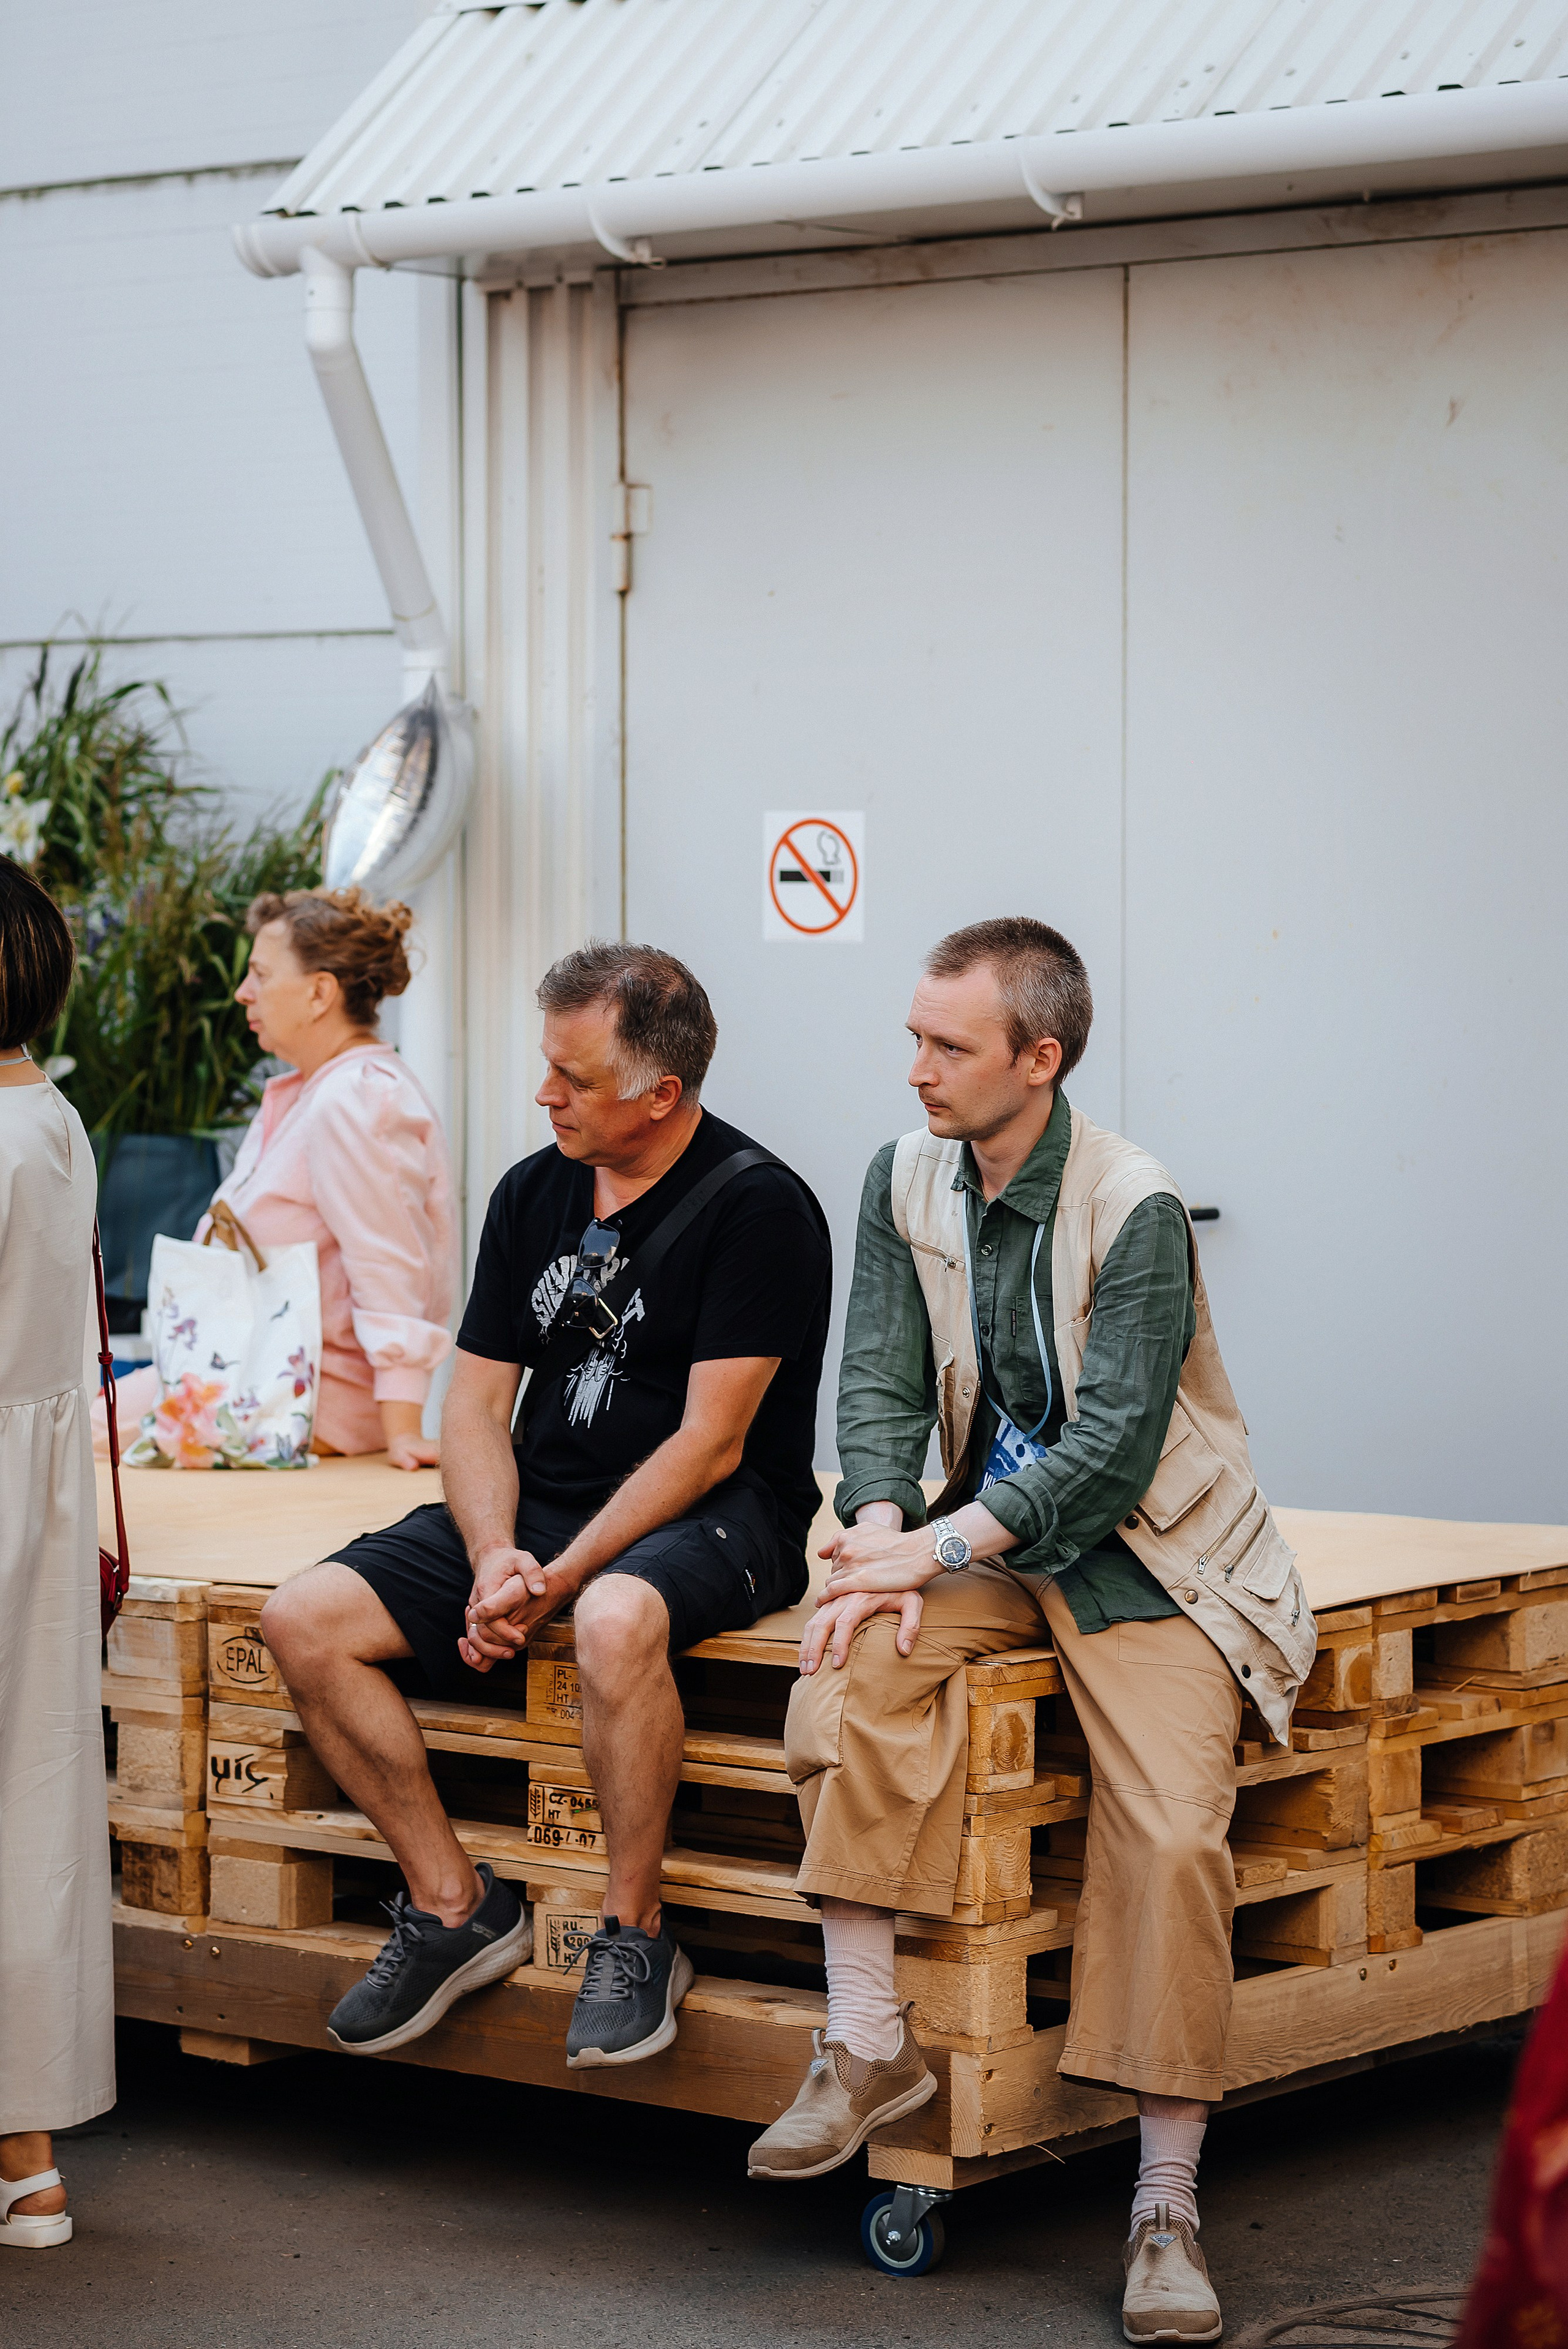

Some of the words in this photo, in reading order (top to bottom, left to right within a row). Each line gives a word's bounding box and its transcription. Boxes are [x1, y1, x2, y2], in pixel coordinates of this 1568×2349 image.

[227, 1646, 267, 1674] EPAL
[556, 1680, 567, 1691] 24
[570, 1683, 582, 1693] 10
[556, 1693, 569, 1703] HT
[548, 1809, 561, 1819] HT
